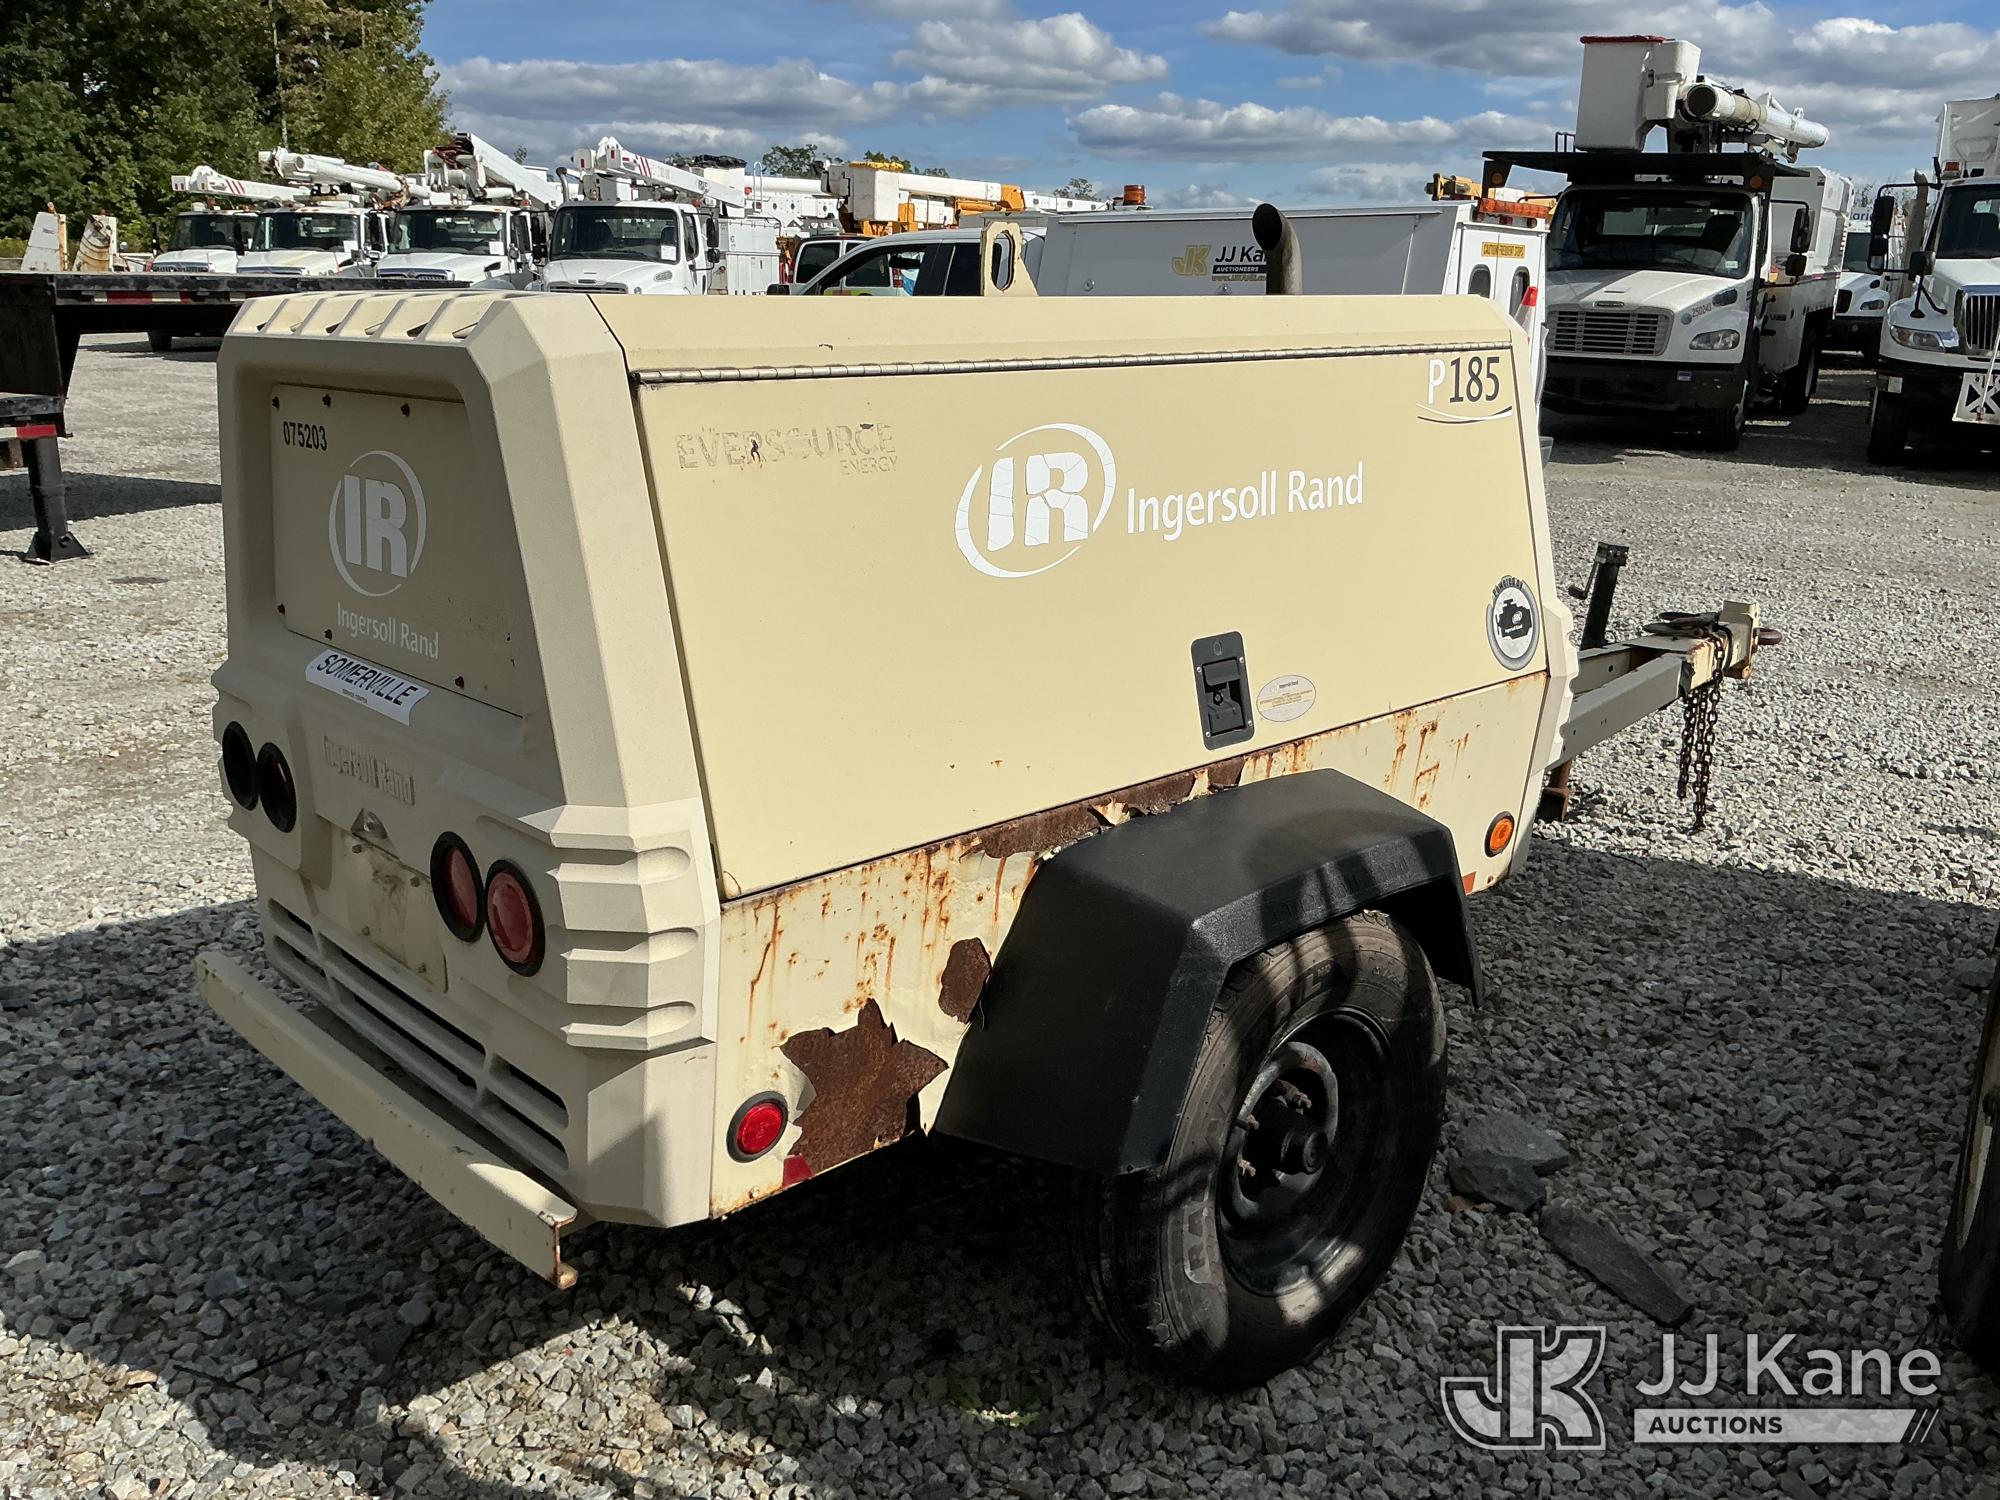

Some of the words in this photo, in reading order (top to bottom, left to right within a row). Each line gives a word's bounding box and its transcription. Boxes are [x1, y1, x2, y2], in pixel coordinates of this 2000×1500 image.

[1214, 246, 1236, 263] JJ
[1240, 246, 1266, 263] Ka
[282, 421, 328, 452] 075203
[675, 422, 897, 469] EVERSOURCE
[839, 455, 898, 476] ENERGY
[1127, 470, 1277, 541] Ingersoll
[1287, 460, 1365, 513] Rand
[336, 602, 397, 644] Ingersoll
[400, 622, 440, 660] Rand
[316, 653, 419, 706] SOMERVILLE
